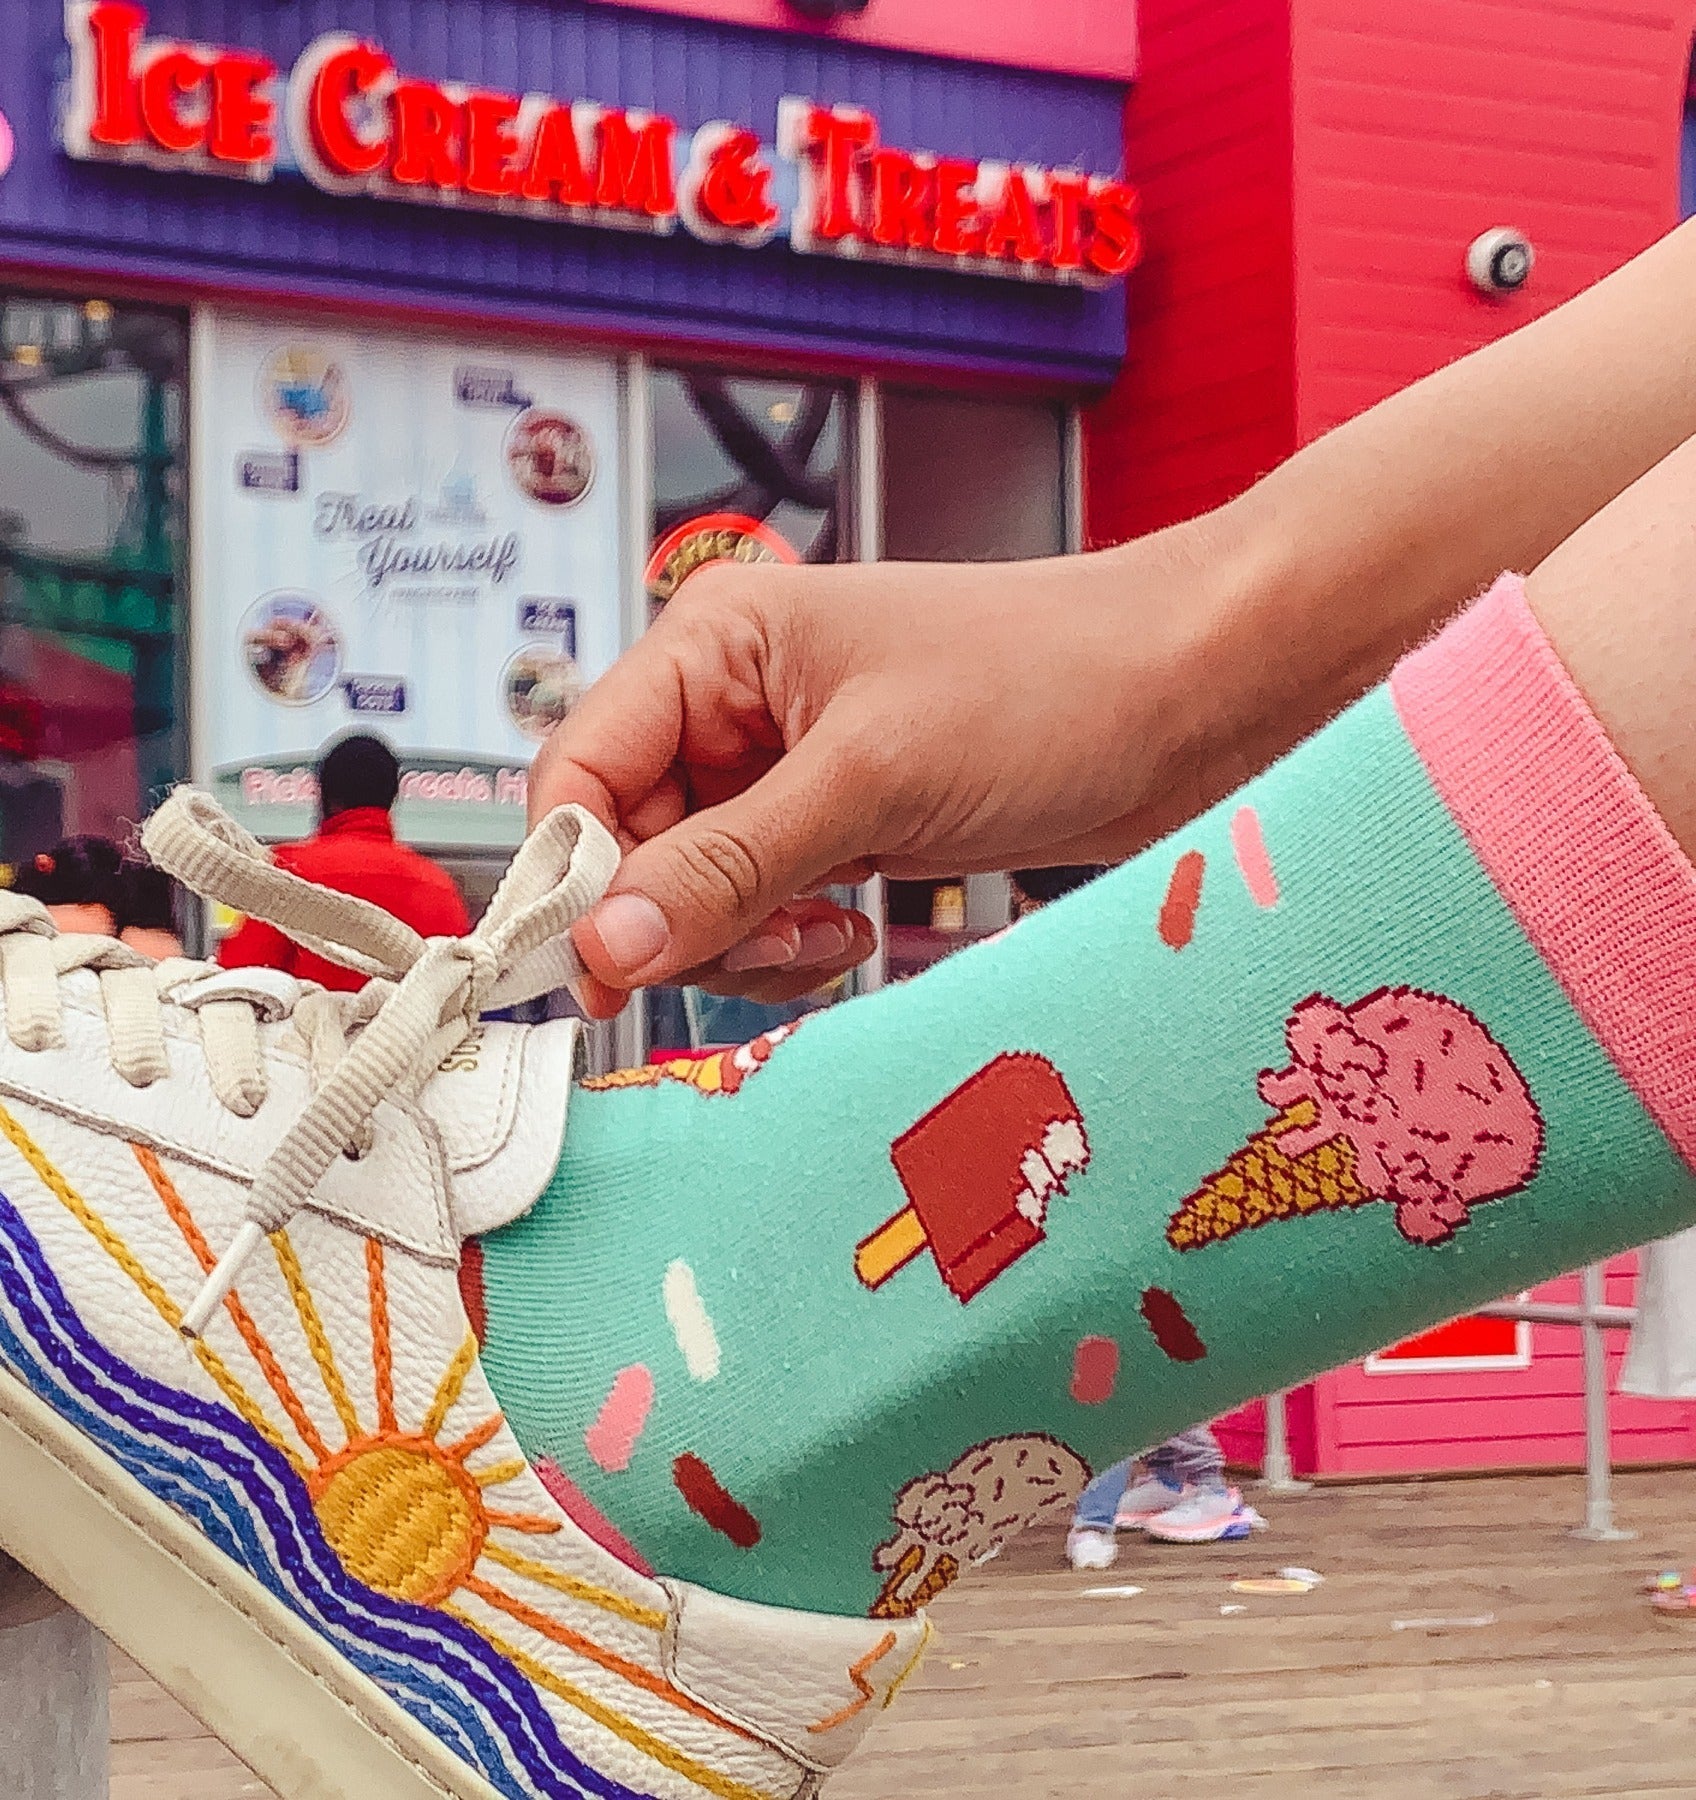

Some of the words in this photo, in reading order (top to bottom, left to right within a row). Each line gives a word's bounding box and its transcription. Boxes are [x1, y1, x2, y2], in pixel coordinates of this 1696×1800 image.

[88, 1, 277, 165] ICE
[306, 38, 678, 218] CREAM
[696, 125, 780, 227] &
[800, 102, 1142, 276] TREATS
[313, 490, 417, 535] Treat
[358, 531, 519, 587] Yourself
[397, 766, 493, 803] reate
